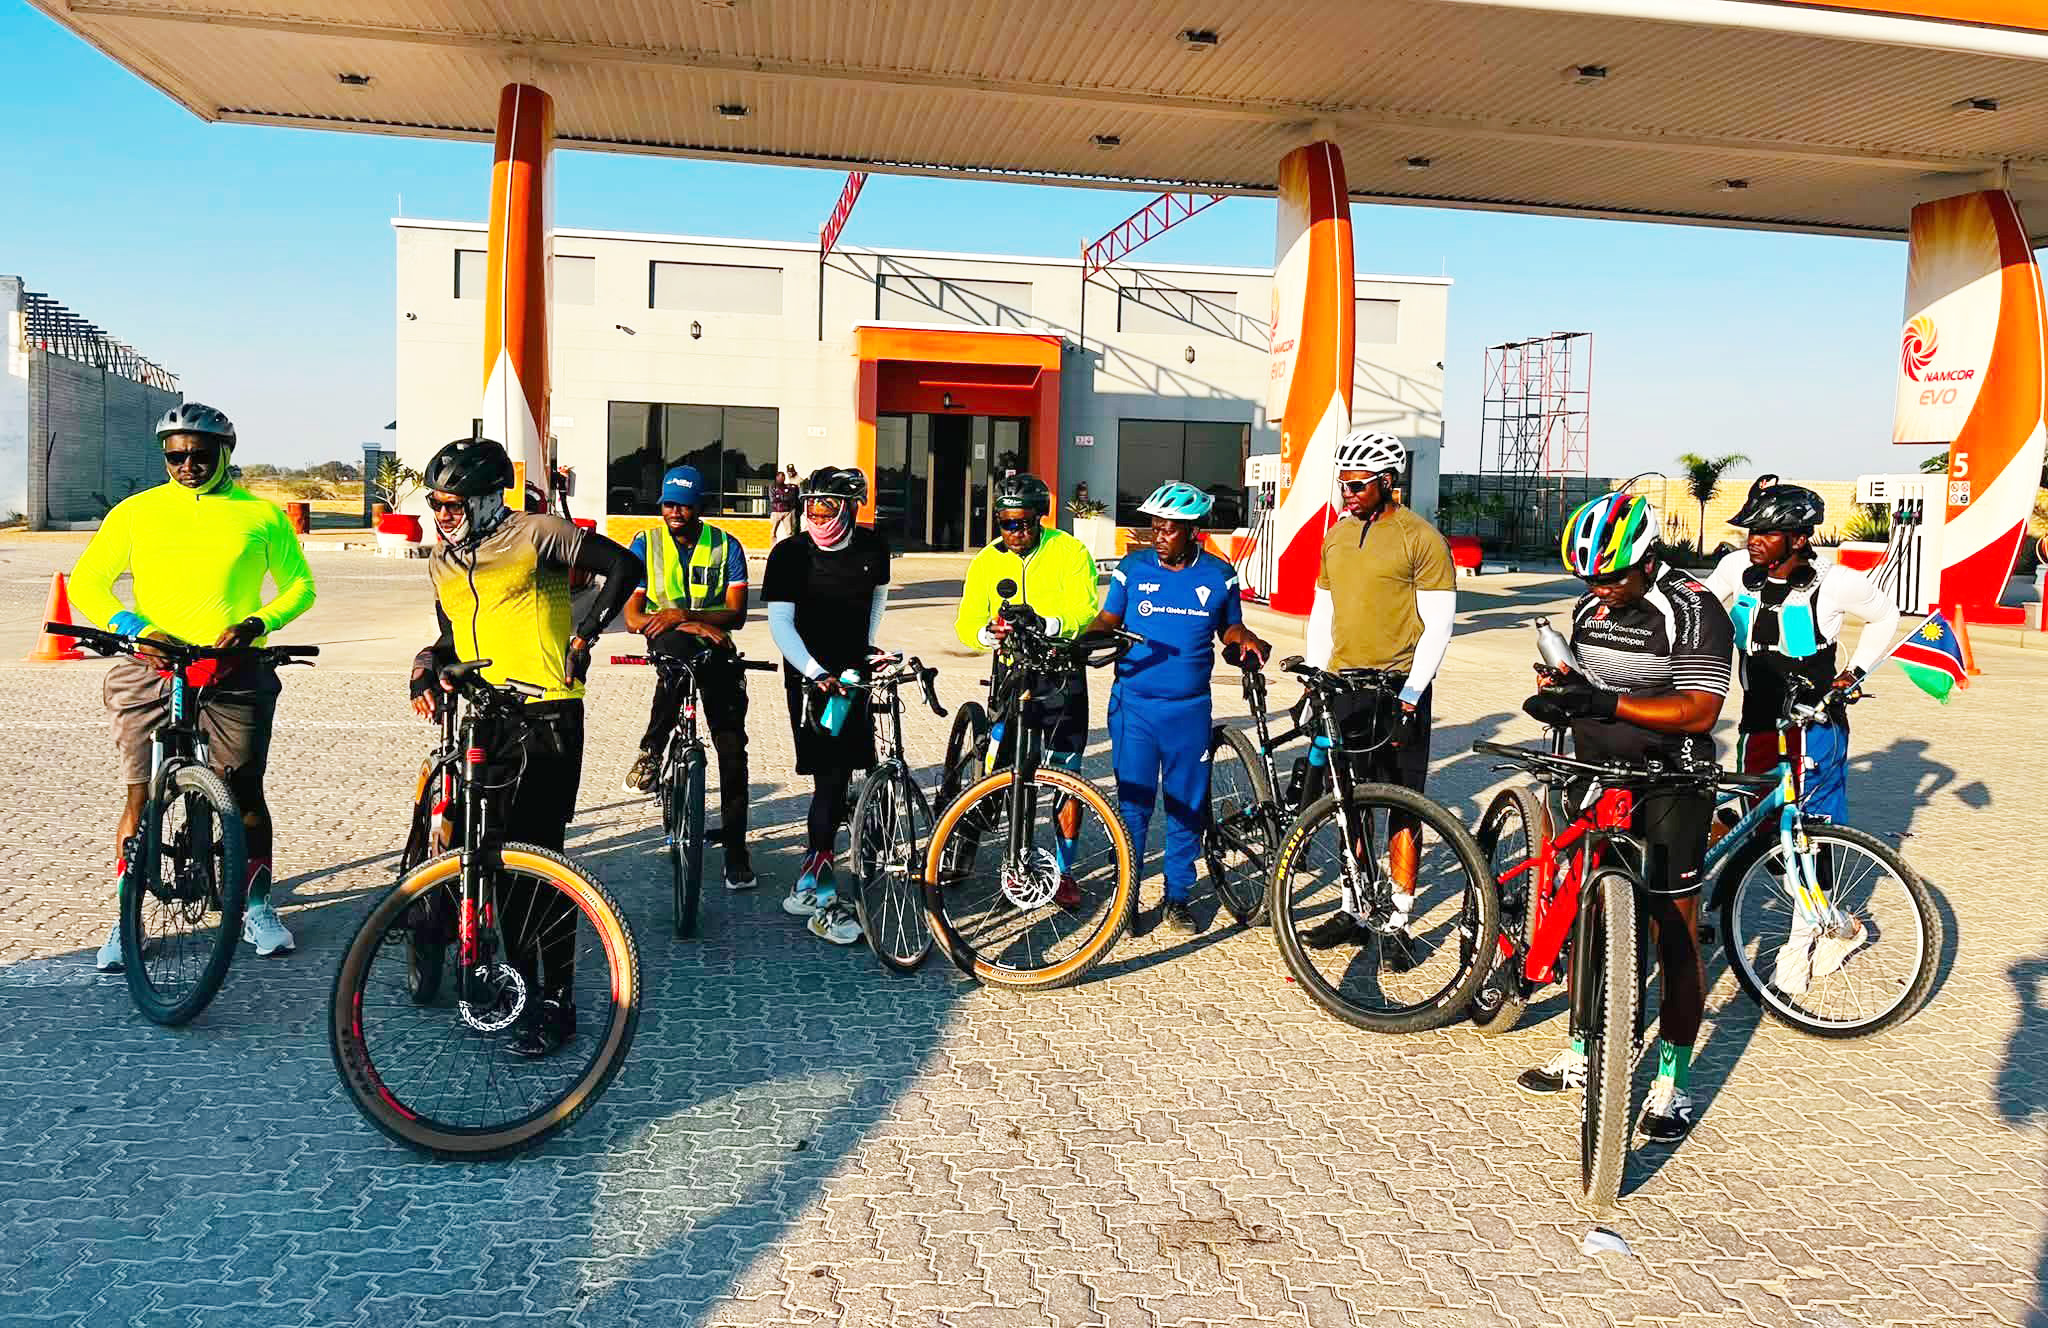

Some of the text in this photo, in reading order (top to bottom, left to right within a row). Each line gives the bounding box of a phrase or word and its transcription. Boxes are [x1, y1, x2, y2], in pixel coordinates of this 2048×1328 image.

[1924, 369, 1975, 383] NAMCOR
[1919, 388, 1958, 405] EVO
[1282, 431, 1291, 459] 3
[1952, 452, 1969, 478] 5
